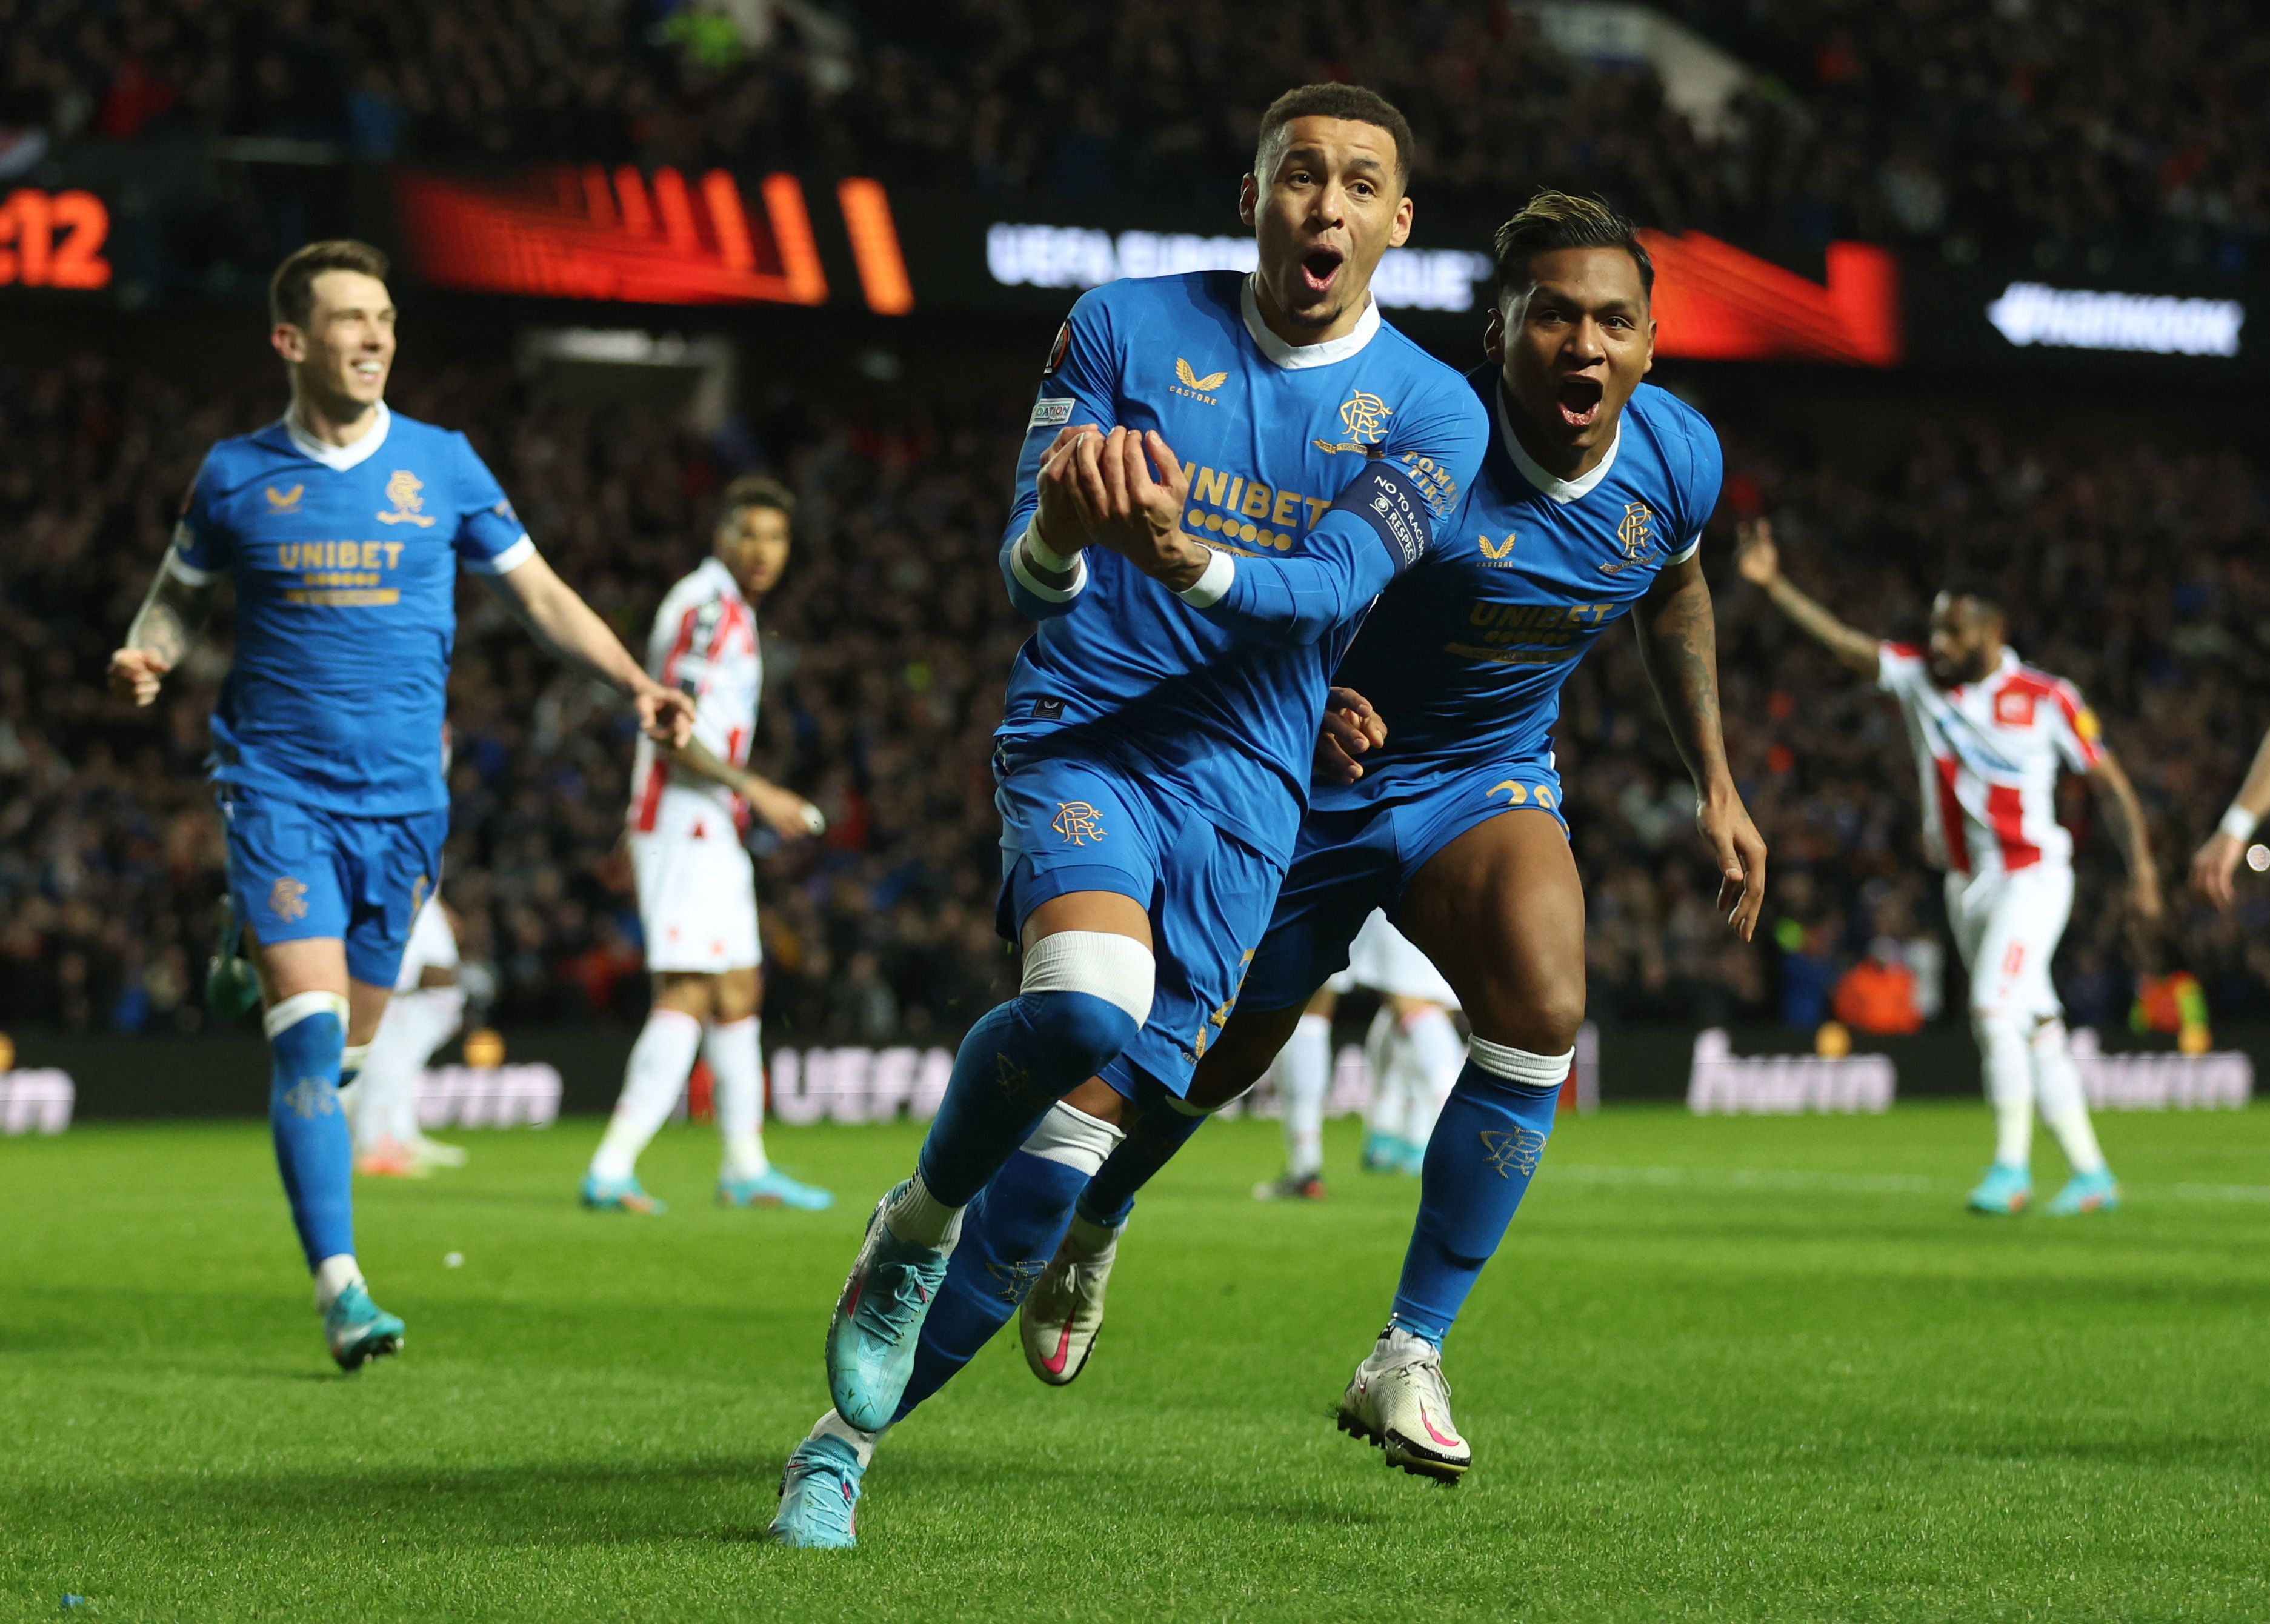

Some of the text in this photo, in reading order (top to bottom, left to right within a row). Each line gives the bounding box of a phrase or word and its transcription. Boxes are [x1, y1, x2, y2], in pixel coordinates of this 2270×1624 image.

[1169, 385, 1217, 406] CASTORE
[1036, 406, 1070, 418] DATION
[1374, 476, 1425, 560] NO TO RACISM
[1388, 512, 1416, 565] RESPECT
[278, 541, 405, 570] UNIBET
[1469, 601, 1614, 630] UNIBET
